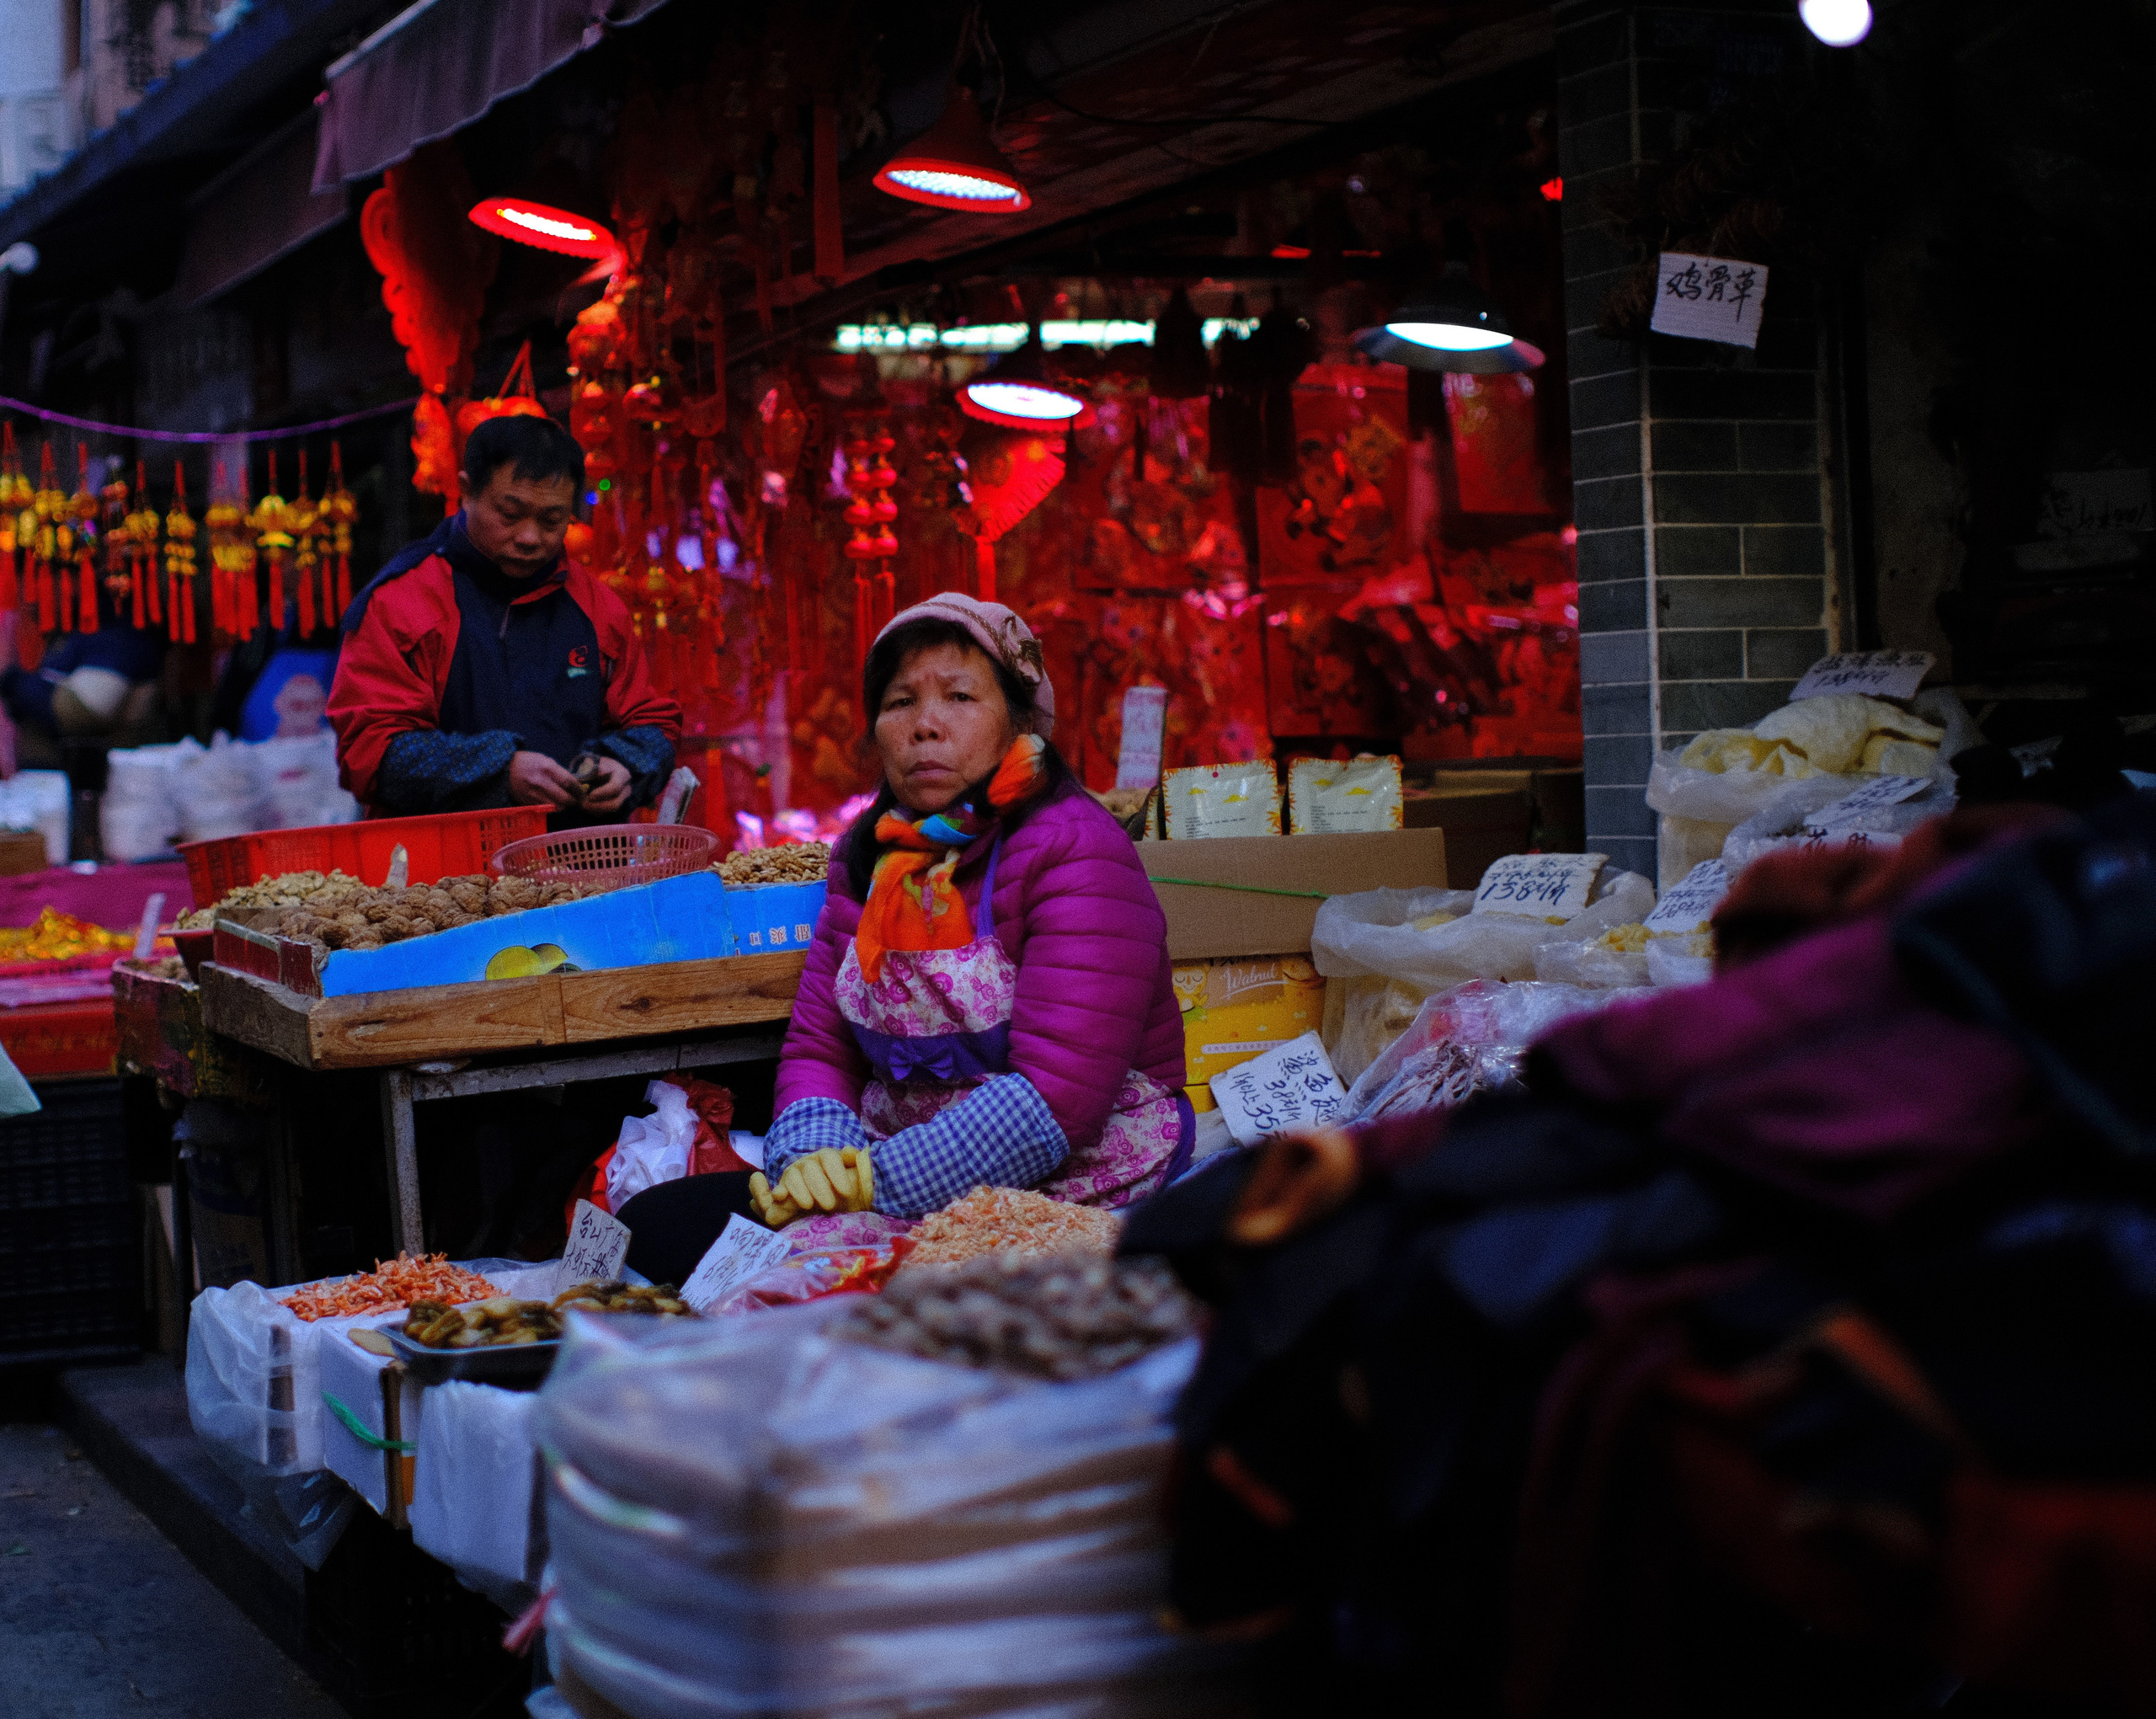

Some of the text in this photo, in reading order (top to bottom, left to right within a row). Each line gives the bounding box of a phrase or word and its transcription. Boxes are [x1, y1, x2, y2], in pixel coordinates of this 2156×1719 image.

[1667, 261, 1755, 323] 鸡骨草
[1220, 963, 1282, 1000] Walnut
